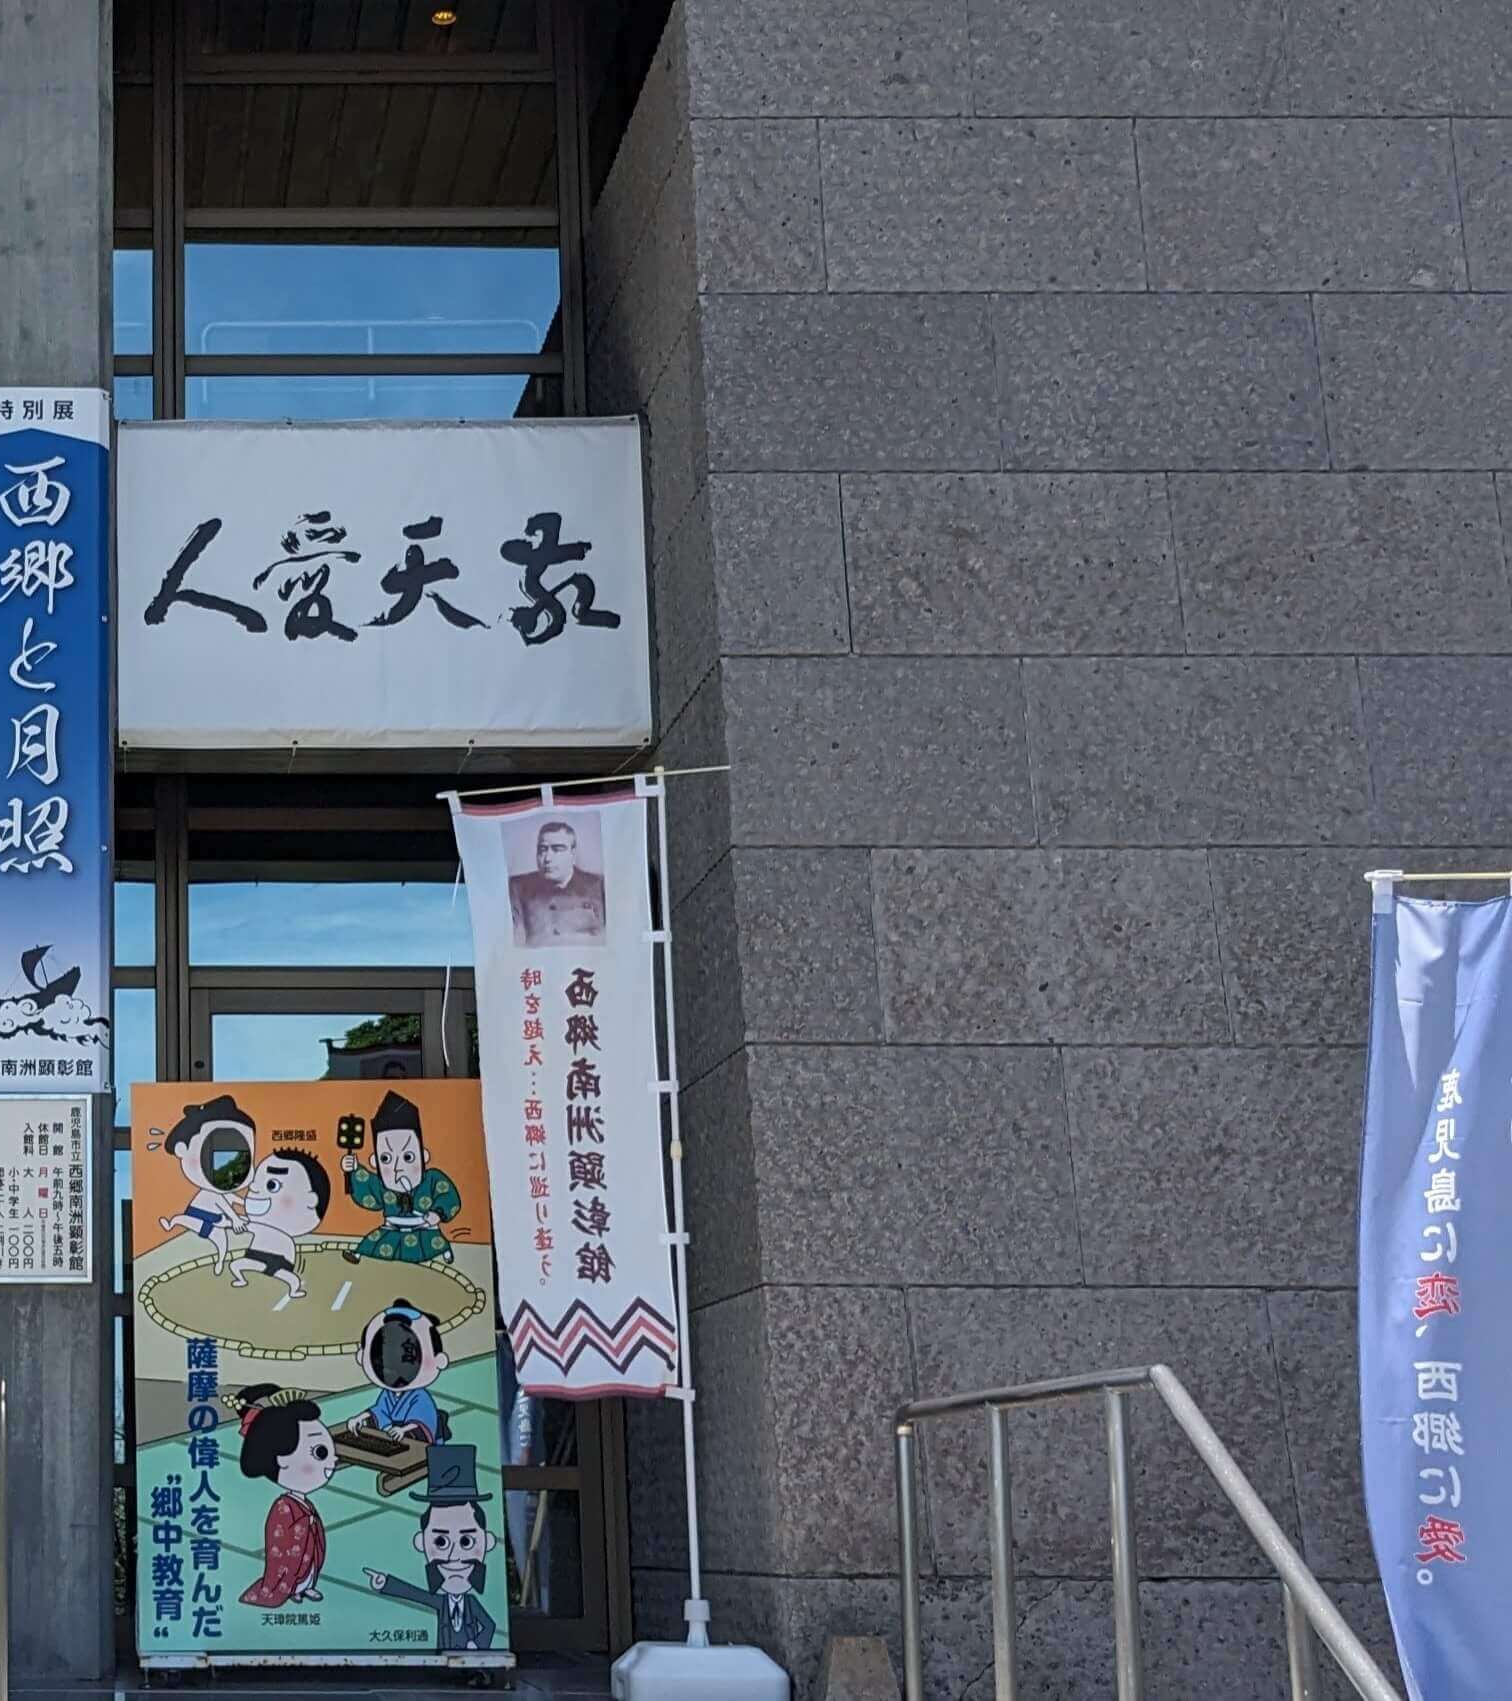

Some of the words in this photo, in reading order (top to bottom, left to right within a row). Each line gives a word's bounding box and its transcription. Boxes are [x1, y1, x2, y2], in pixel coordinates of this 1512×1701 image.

[143, 511, 621, 647] 敬天愛人
[186, 1338, 223, 1639] 薩摩の偉人を育んだ
[369, 1629, 429, 1643] 大久保利通
